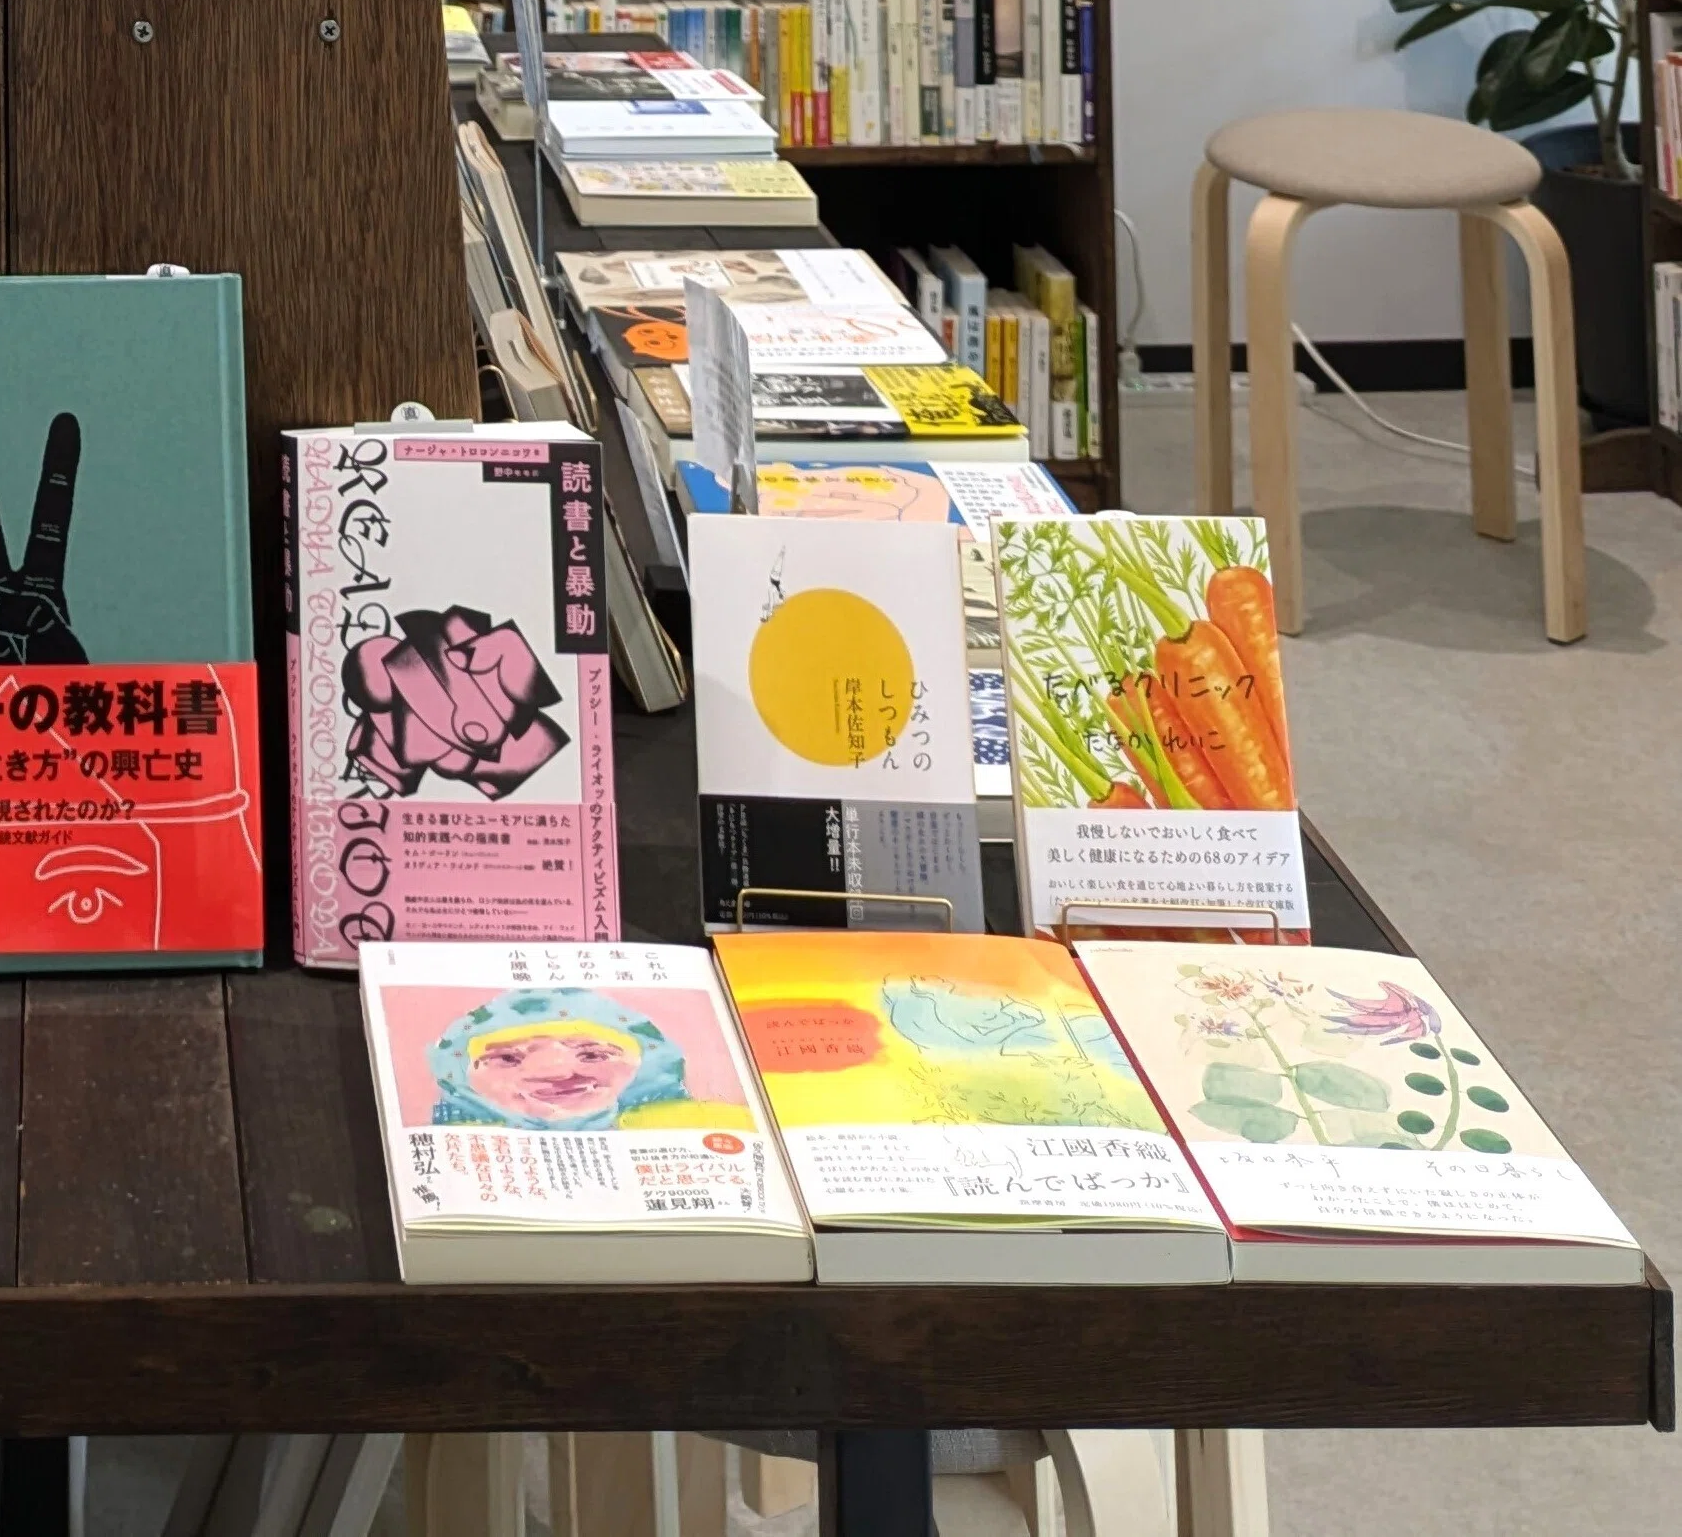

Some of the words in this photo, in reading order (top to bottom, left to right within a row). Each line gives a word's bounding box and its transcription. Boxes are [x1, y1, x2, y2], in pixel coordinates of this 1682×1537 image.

[561, 461, 596, 636] 読書と暴動
[1043, 671, 1257, 703] たべるクリニック
[846, 677, 866, 769] 岸本佐知子
[879, 679, 900, 770] しつもん
[909, 680, 932, 773] ひみつの
[1084, 729, 1227, 753] たなかれいこ
[402, 813, 571, 827] 生きる喜びとユーモアに満ちた
[1076, 825, 1259, 842] 我慢しないでおいしく食べて
[1047, 847, 1291, 867] 美しく健康になるための68のアイデア
[409, 1133, 440, 1175] 穂村弘
[1027, 1137, 1171, 1162] 江國香織
[636, 1163, 745, 1174] 僕はライバル
[639, 1175, 751, 1186] だと思ってる。
[944, 1172, 1190, 1197] 『読んでばっか』
[645, 1197, 715, 1211] 蓮見翔
